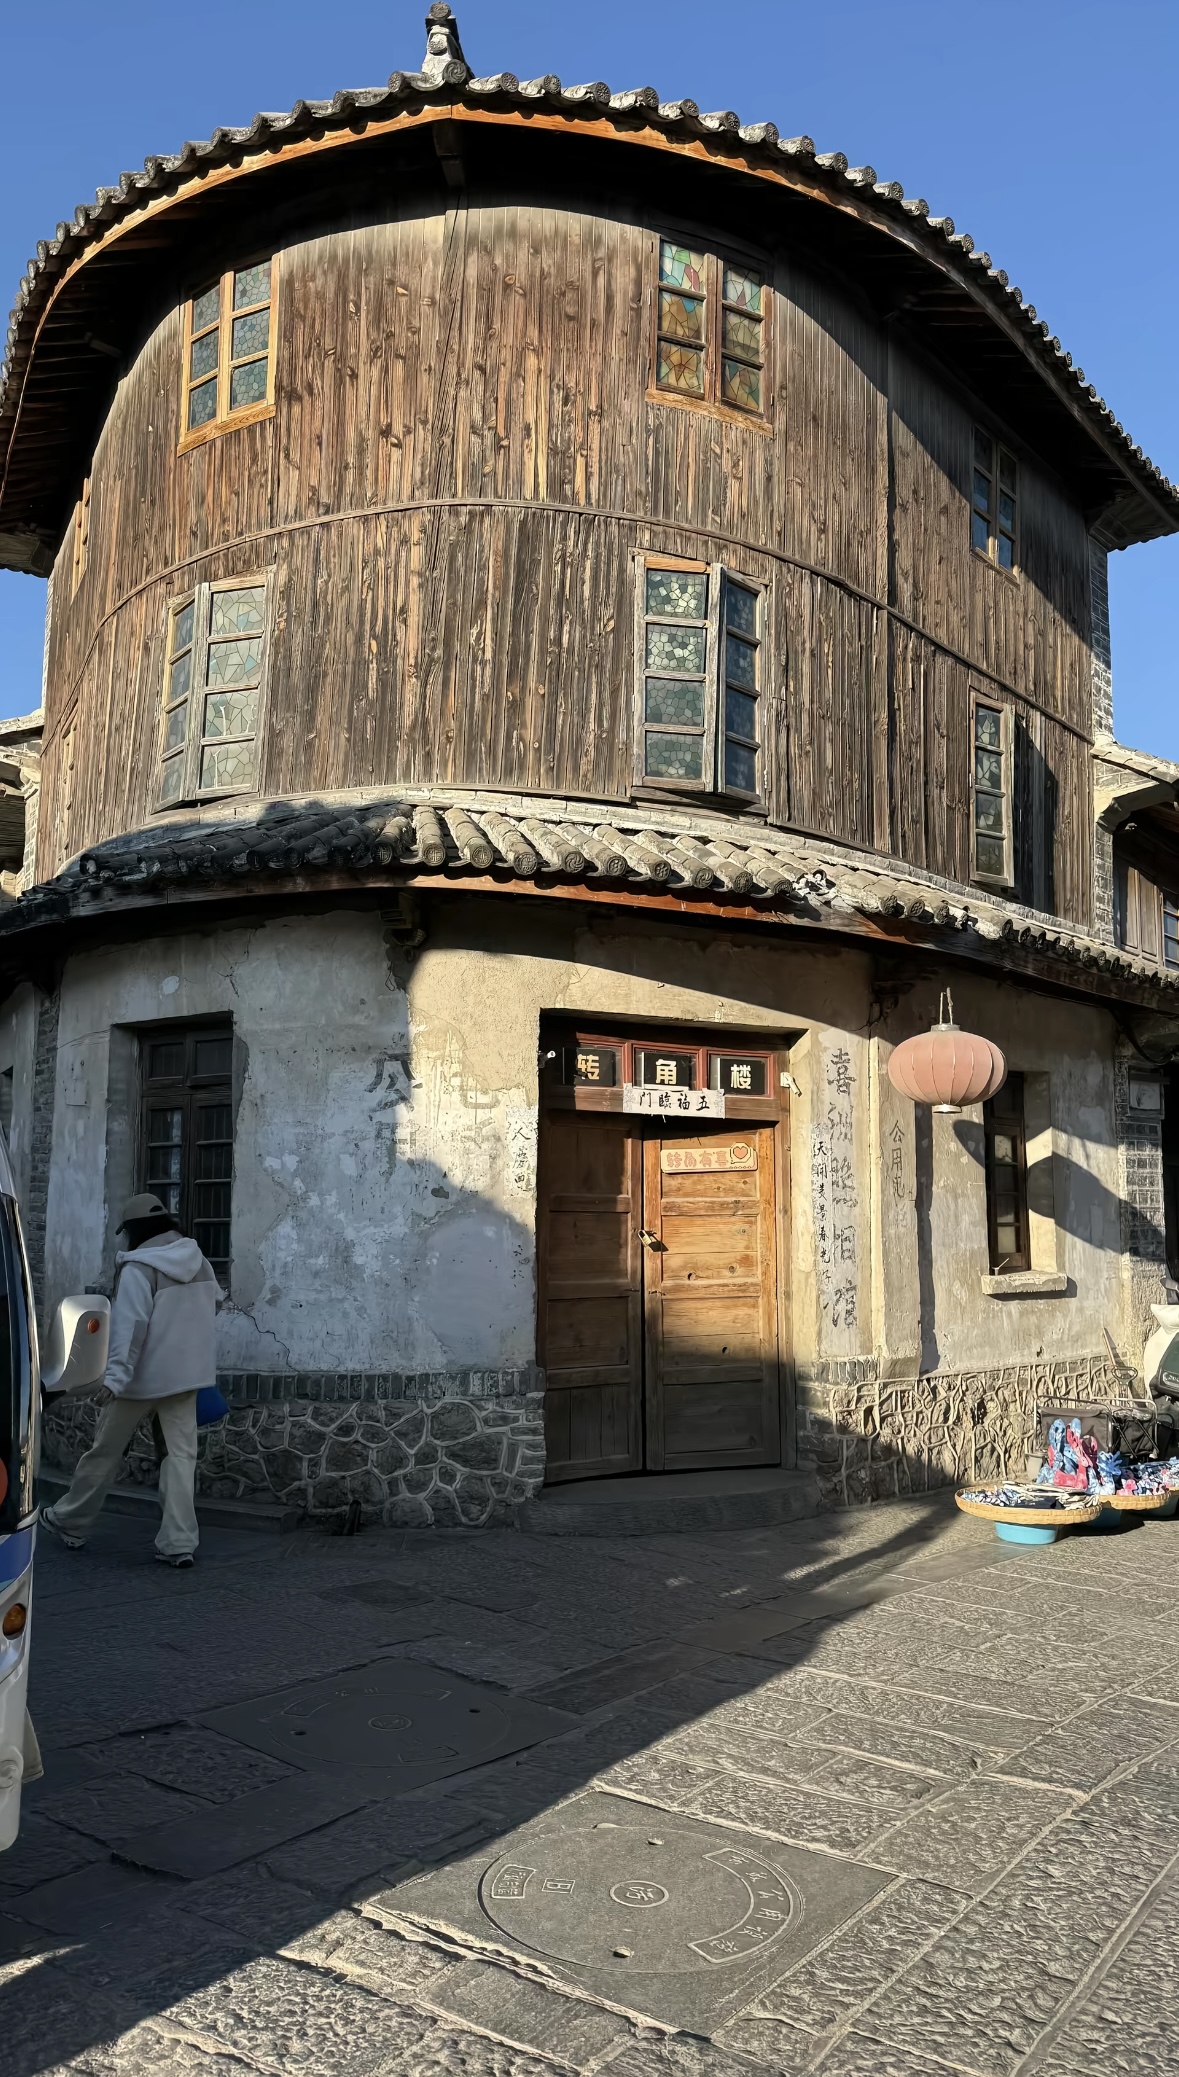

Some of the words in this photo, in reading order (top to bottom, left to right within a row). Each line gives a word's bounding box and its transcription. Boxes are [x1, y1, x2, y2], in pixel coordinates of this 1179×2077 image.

[577, 1053, 752, 1090] 转角楼
[666, 1148, 729, 1168] 转角有喜
